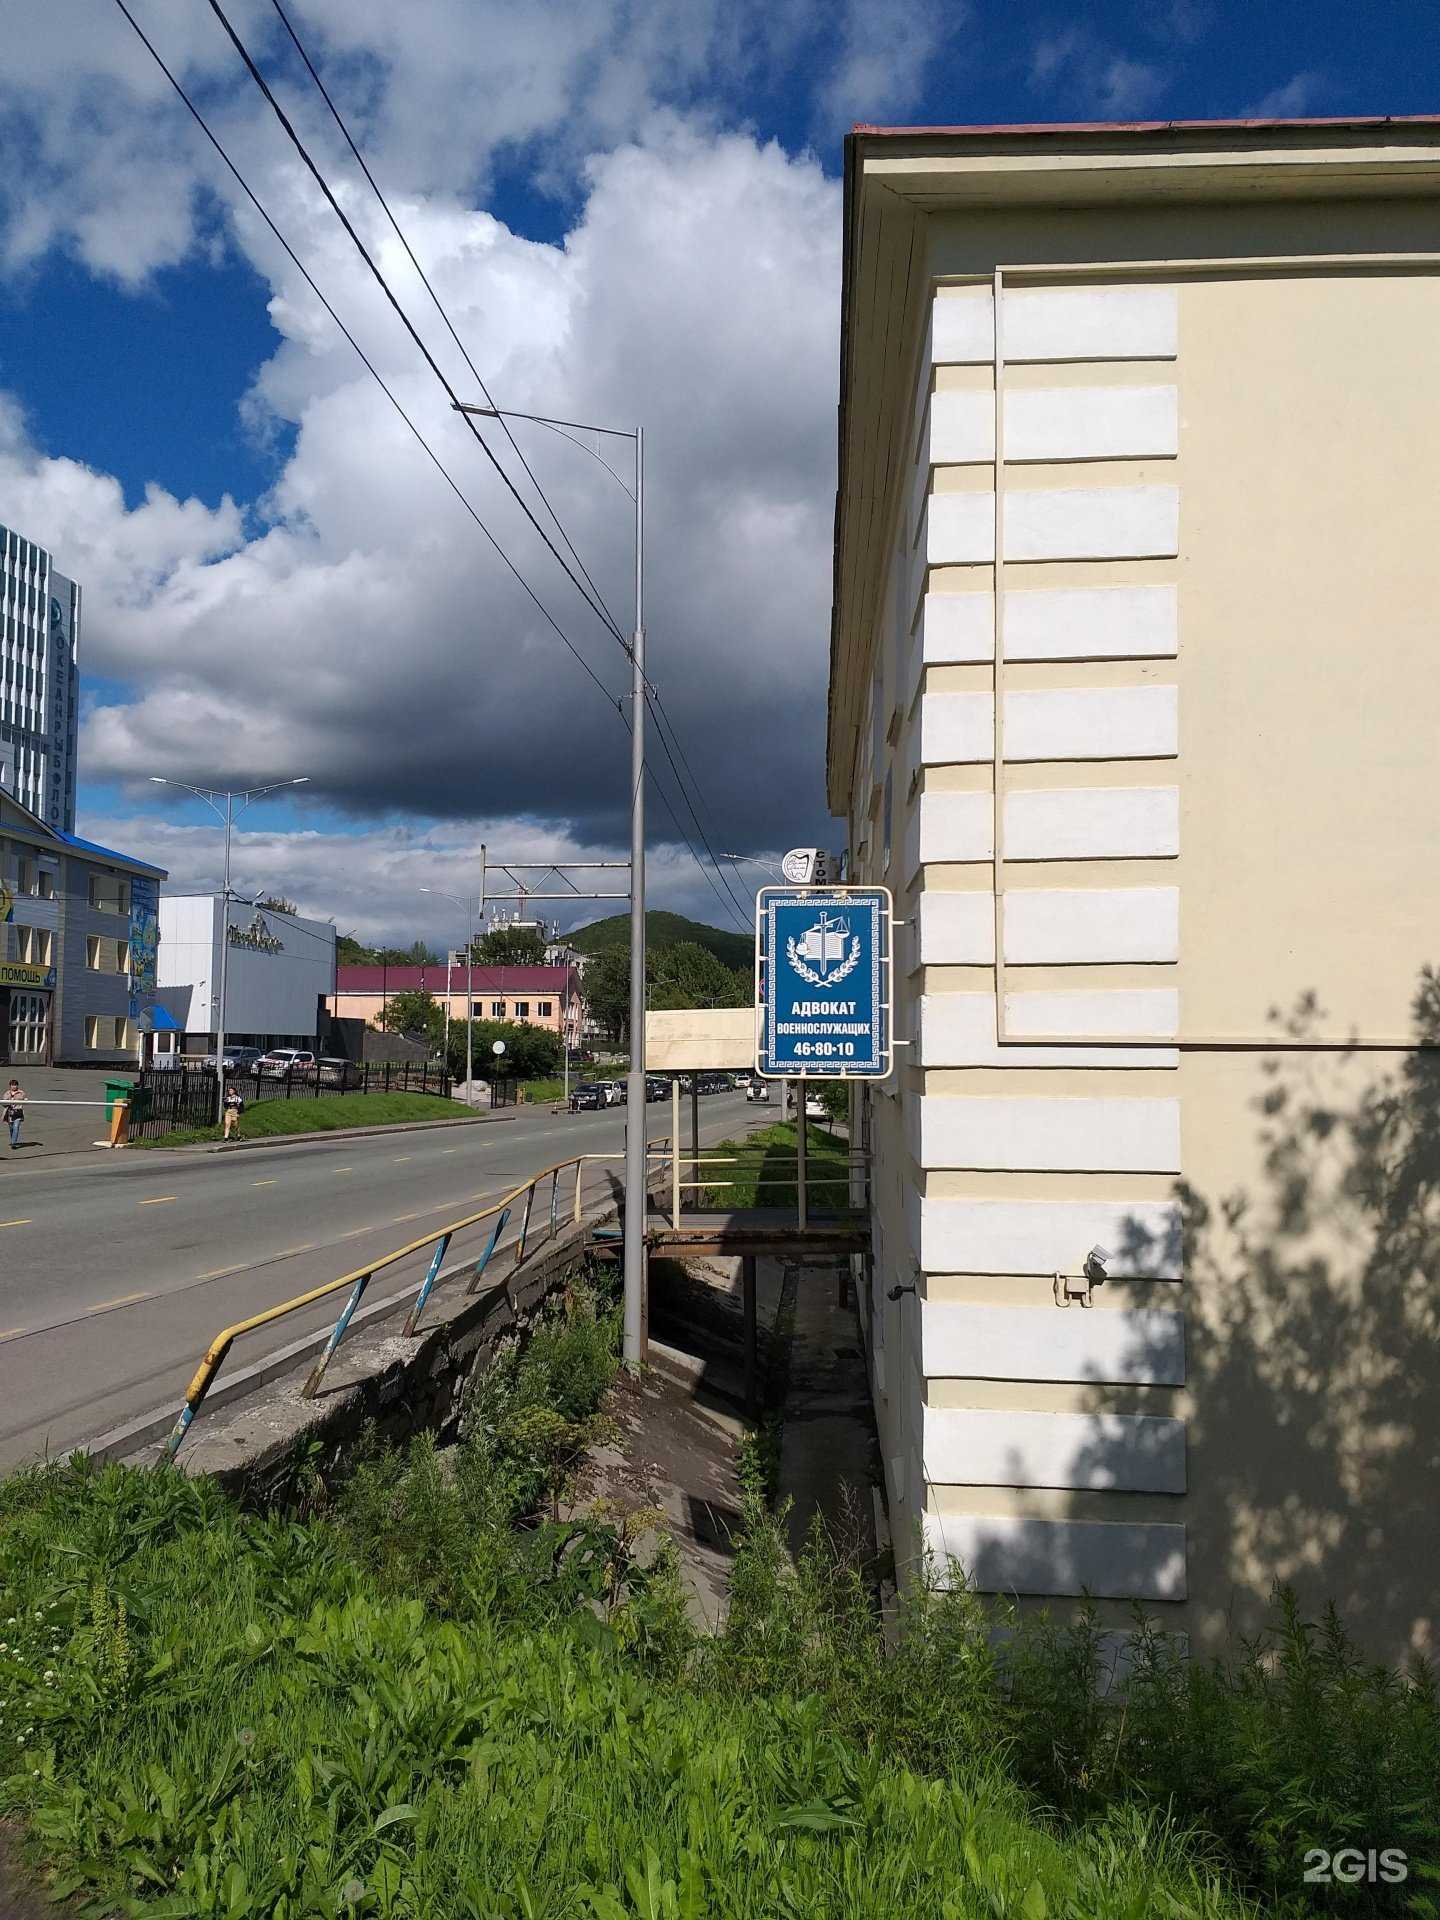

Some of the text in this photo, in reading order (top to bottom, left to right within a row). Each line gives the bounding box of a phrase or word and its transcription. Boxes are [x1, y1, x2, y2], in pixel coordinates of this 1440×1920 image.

[1, 967, 41, 983] ПОМОЩЬ
[791, 1001, 857, 1017] АДВОКАТ
[776, 1022, 871, 1036] ВОЕННОСЛУЖАЩИХ
